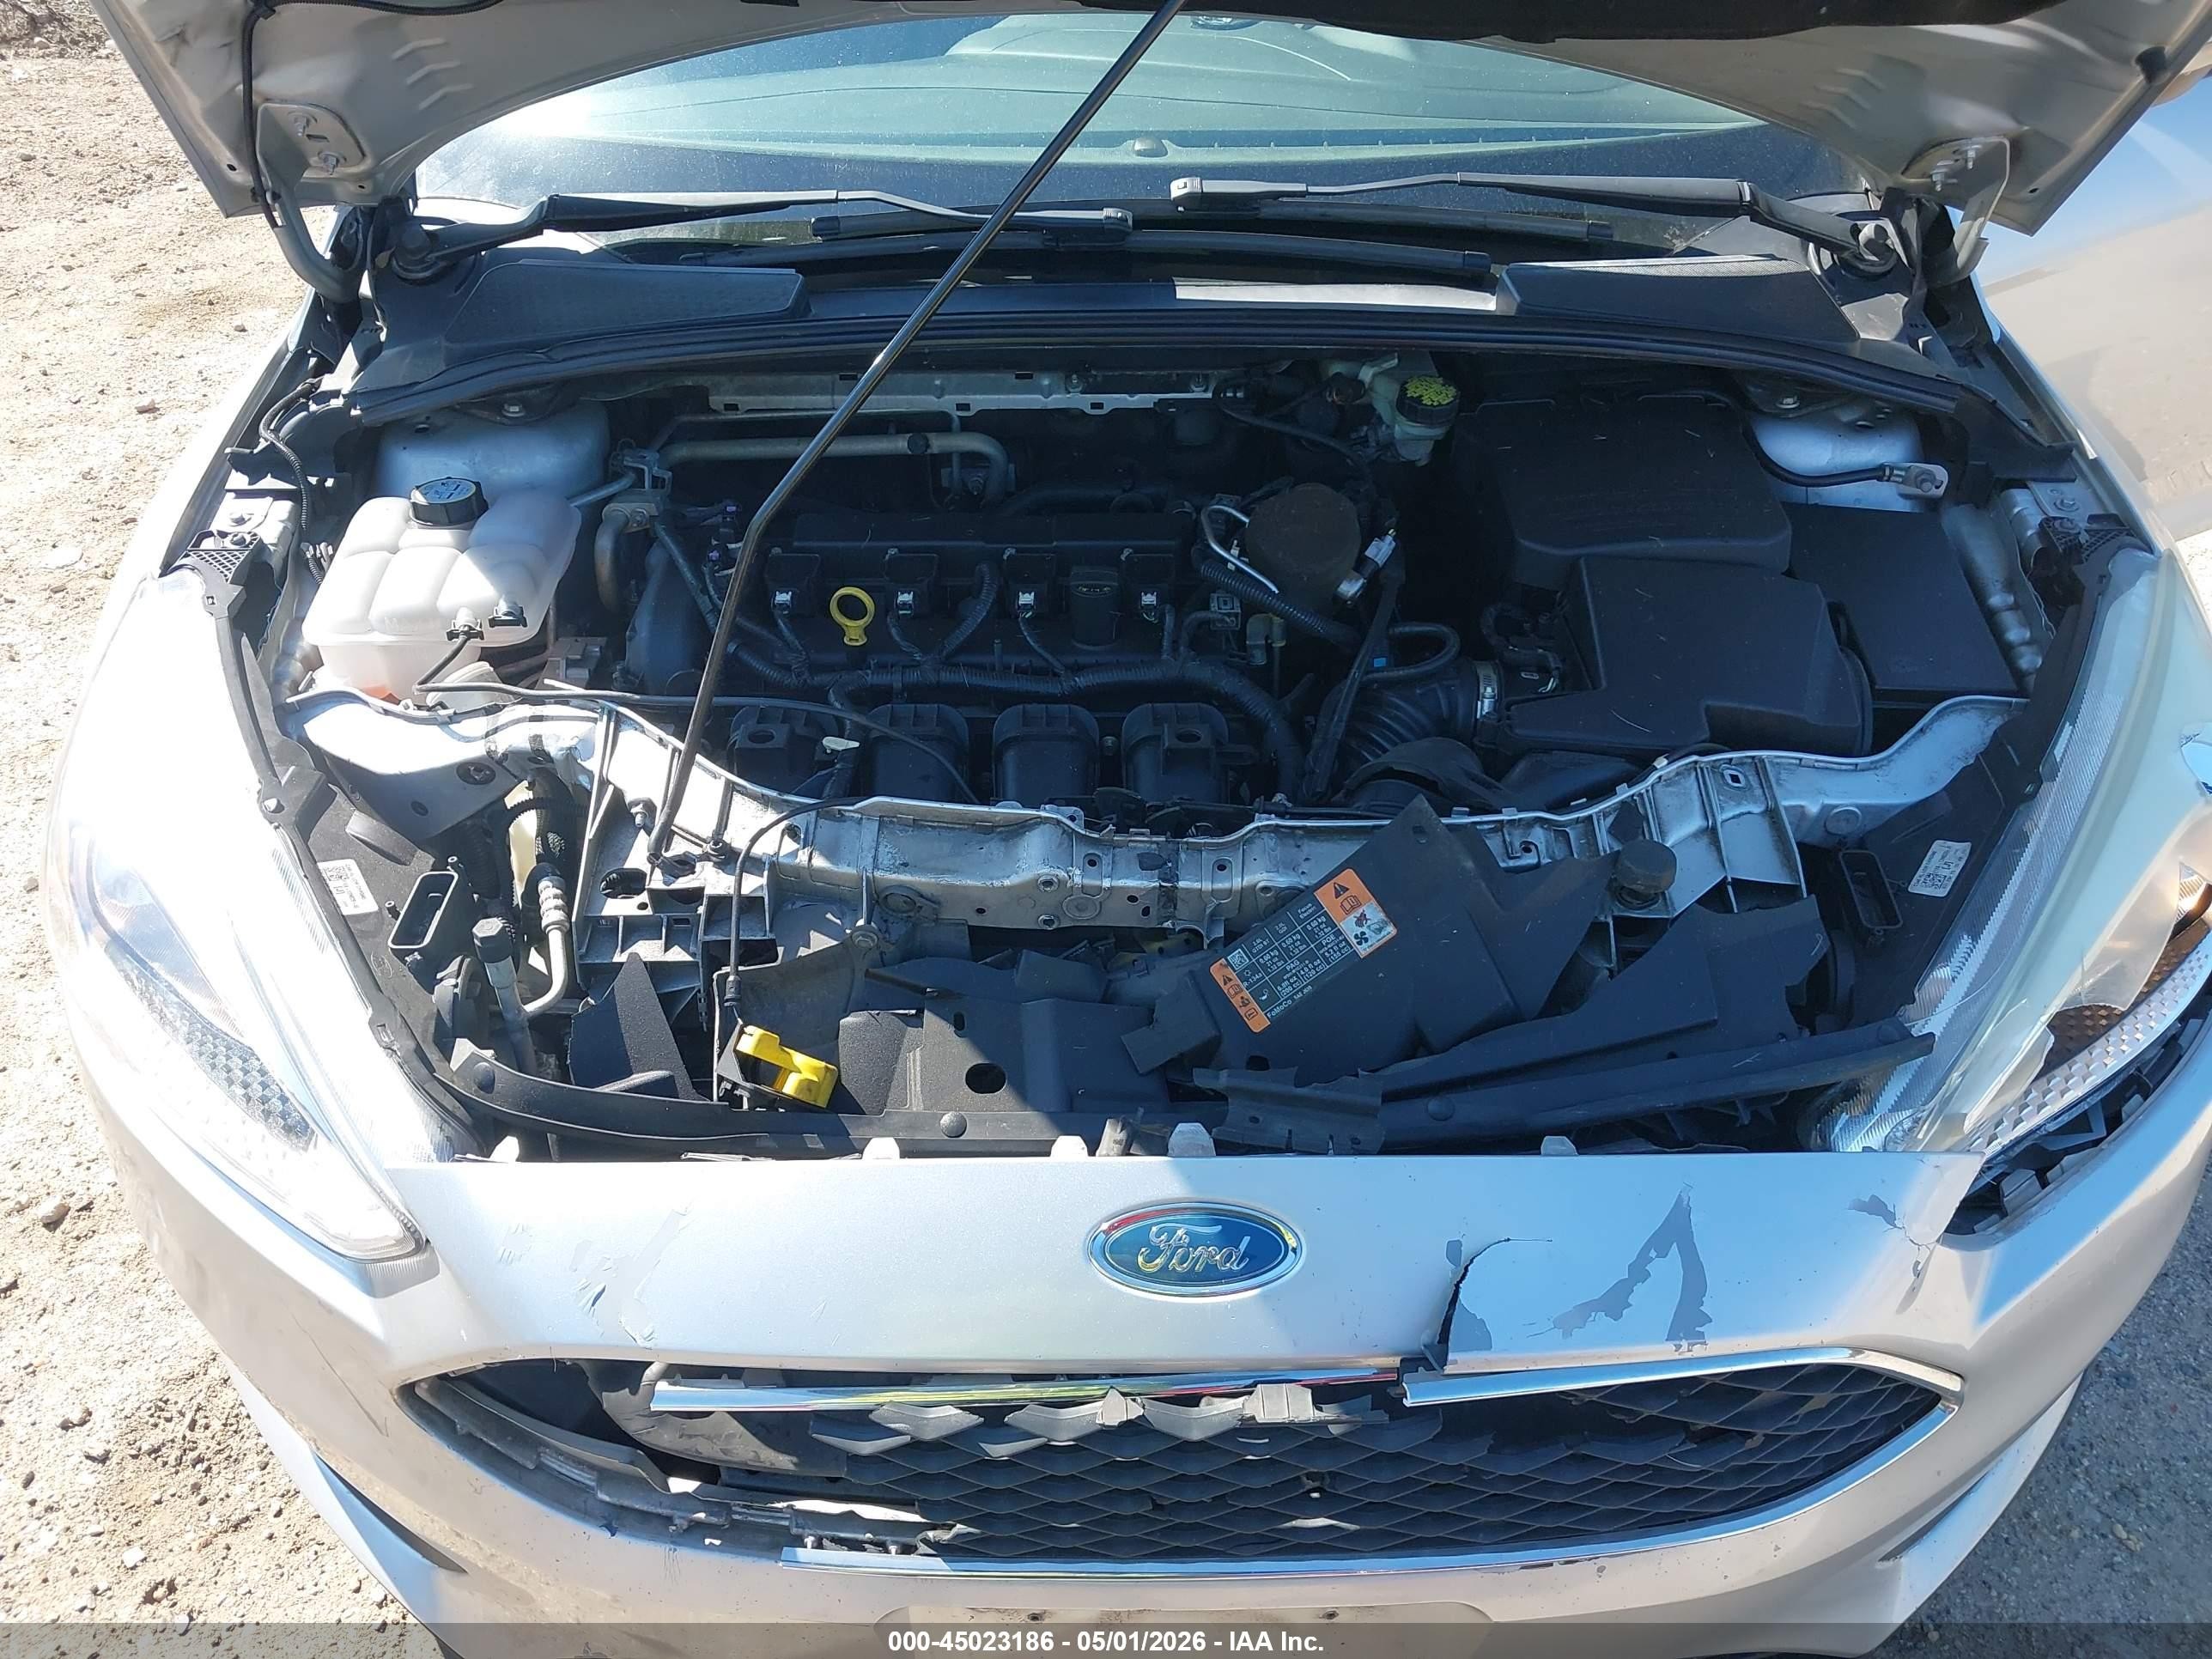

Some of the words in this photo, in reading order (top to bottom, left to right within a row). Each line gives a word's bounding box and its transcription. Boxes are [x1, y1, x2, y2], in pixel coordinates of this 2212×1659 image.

[1306, 921, 1318, 930] 0.60
[1316, 915, 1326, 924] kg
[1281, 938, 1293, 948] 0.60
[1291, 933, 1301, 941] kg
[1322, 934, 1335, 945] POE
[1259, 954, 1270, 963] 0.60
[1269, 949, 1279, 957] kg
[1340, 945, 1351, 954] cc)
[1285, 960, 1299, 971] PAG
[1315, 963, 1325, 972] cc)
[1243, 972, 1262, 987] R-134a
[1267, 999, 1292, 1018] FoMoCo
[1137, 1222, 1251, 1273] Ford
